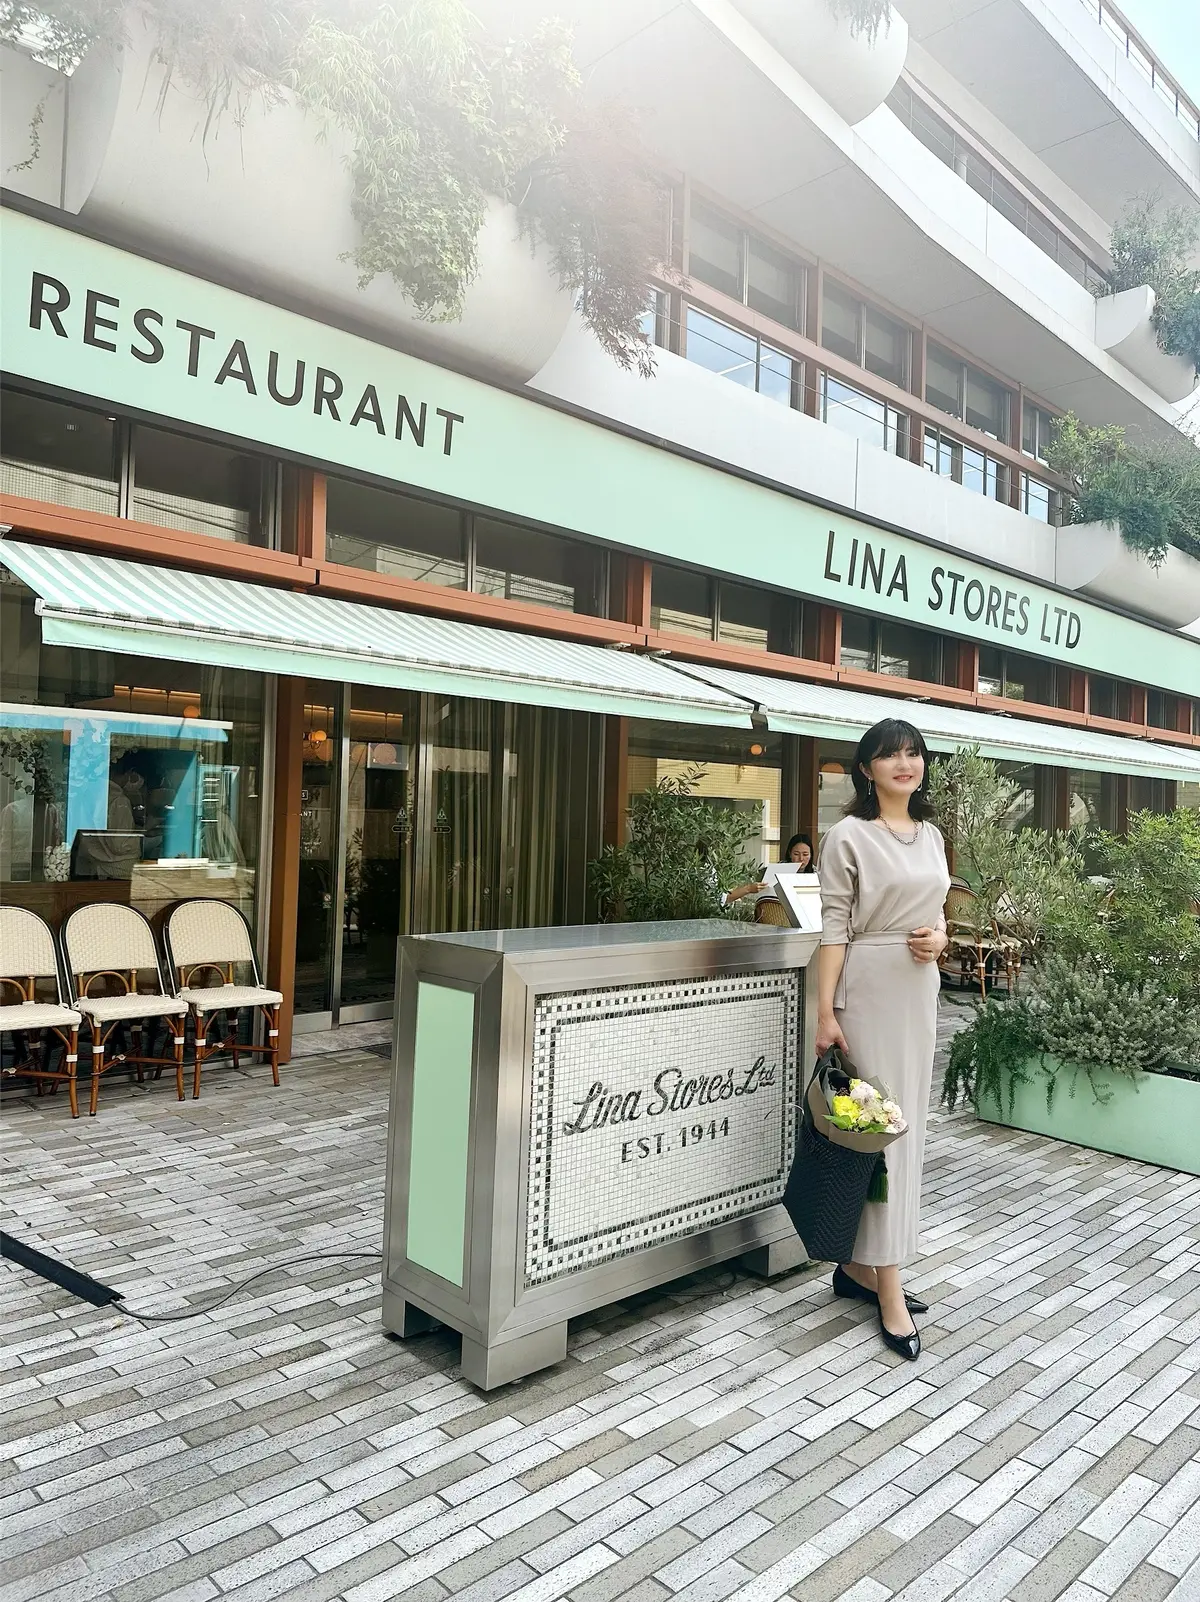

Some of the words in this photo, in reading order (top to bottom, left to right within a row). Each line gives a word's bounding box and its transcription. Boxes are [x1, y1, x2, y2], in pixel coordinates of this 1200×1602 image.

[29, 271, 464, 456] RESTAURANT
[823, 530, 909, 602] LINA
[928, 566, 1030, 636] STORES
[1040, 603, 1081, 649] LTD
[563, 1081, 642, 1136] Lina
[735, 1055, 776, 1096] Ltd
[621, 1132, 671, 1164] EST.
[678, 1116, 729, 1148] 1944
